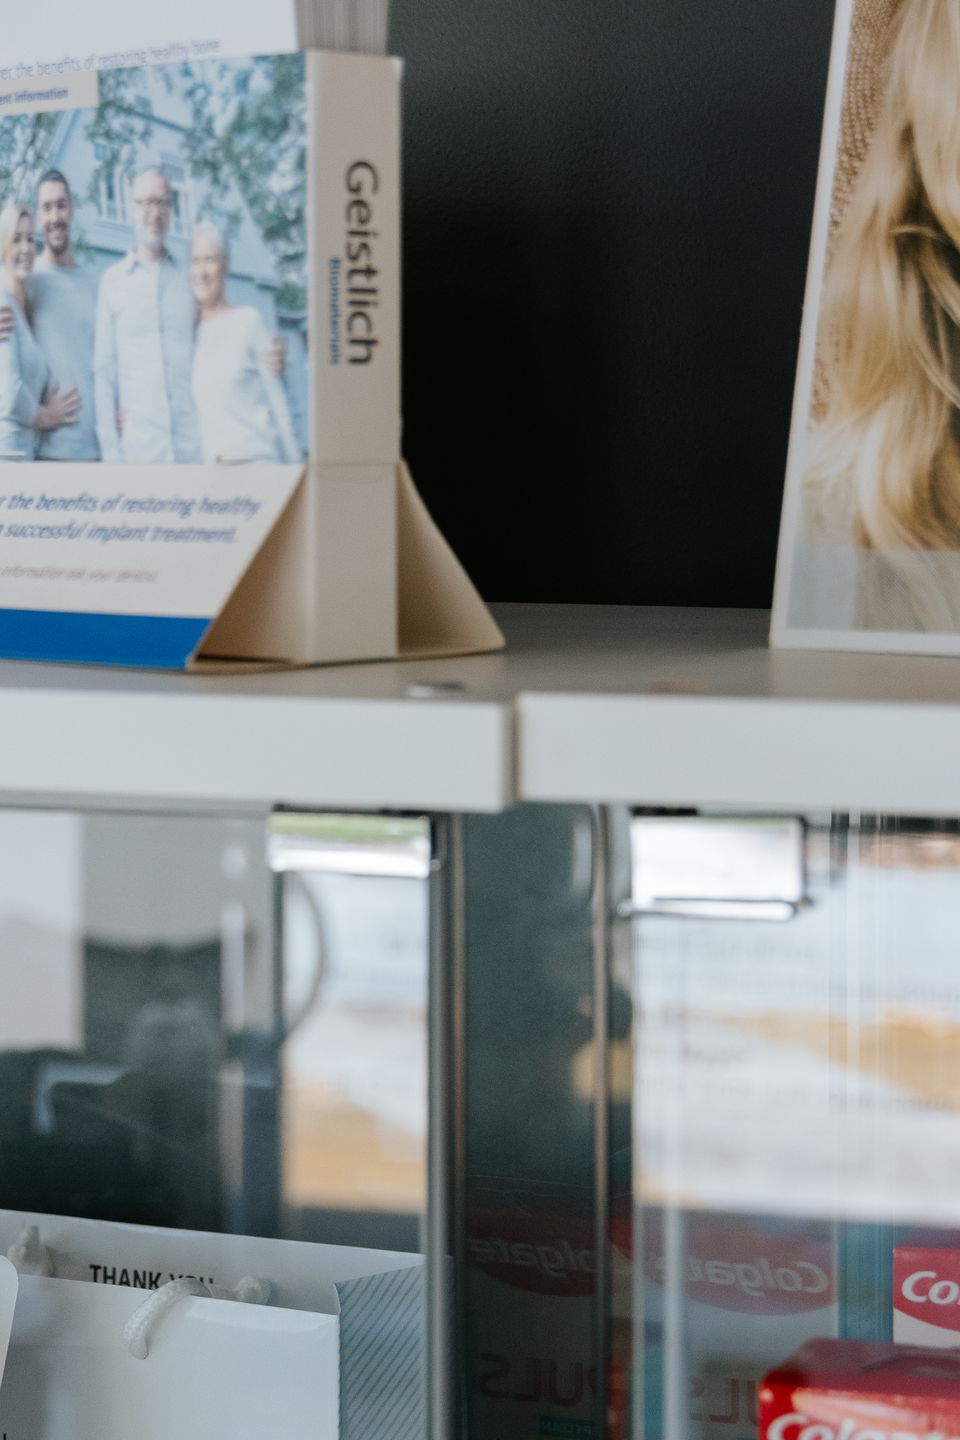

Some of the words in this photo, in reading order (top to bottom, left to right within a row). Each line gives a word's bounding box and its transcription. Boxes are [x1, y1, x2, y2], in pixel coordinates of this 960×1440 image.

[16, 64, 34, 78] the
[36, 57, 81, 75] benefits
[346, 160, 379, 365] Geistlich
[8, 492, 35, 511] the
[38, 494, 98, 512] benefits
[101, 494, 119, 514] of
[121, 497, 195, 518] restoring
[199, 496, 262, 519] healthy
[5, 521, 86, 540] successful
[88, 525, 149, 544] implant
